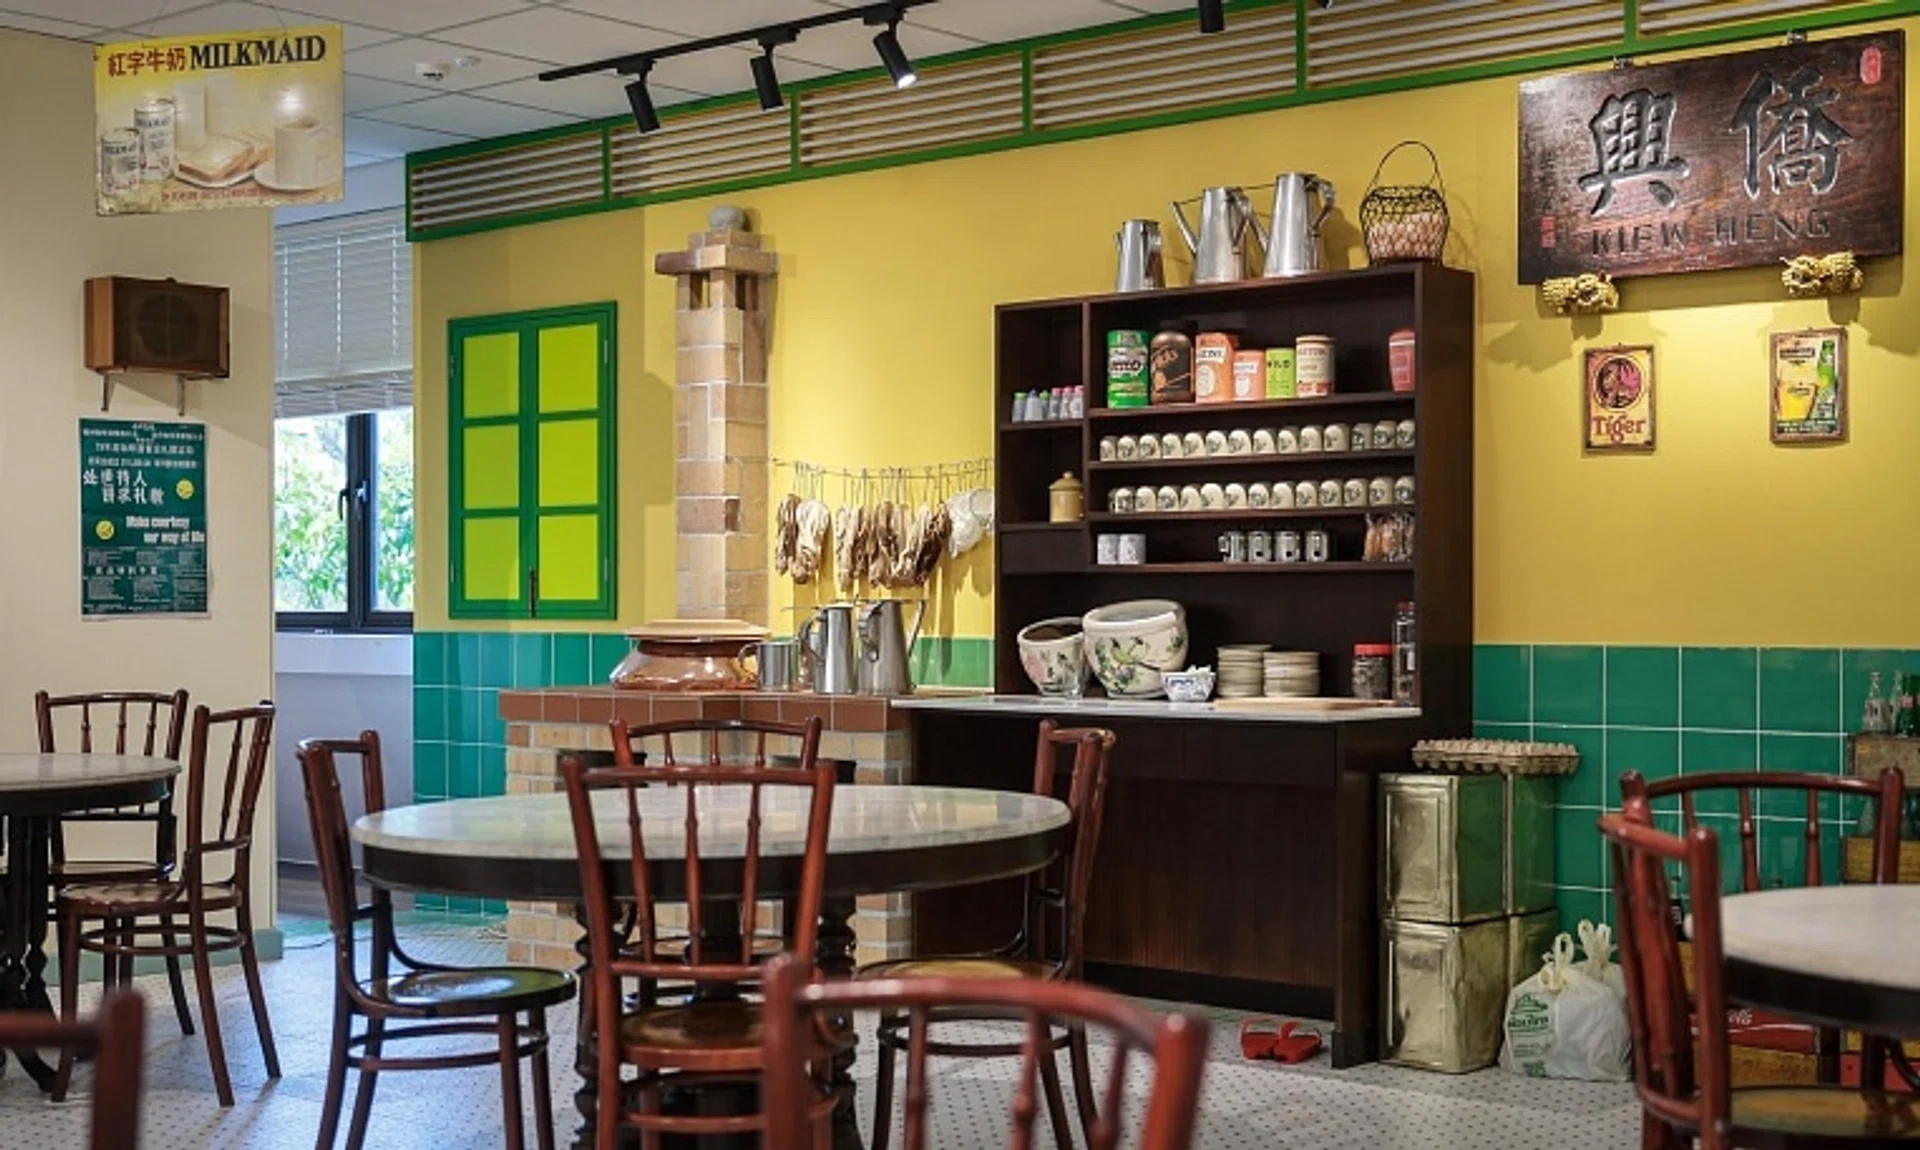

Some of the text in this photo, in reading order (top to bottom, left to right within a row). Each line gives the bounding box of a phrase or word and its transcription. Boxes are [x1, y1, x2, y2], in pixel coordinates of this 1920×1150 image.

[108, 47, 187, 77] 紅字牛奶
[189, 35, 326, 70] MILKMAID
[1591, 221, 1688, 256] KIEW
[1714, 208, 1831, 248] HENG
[1592, 414, 1647, 442] Tiger
